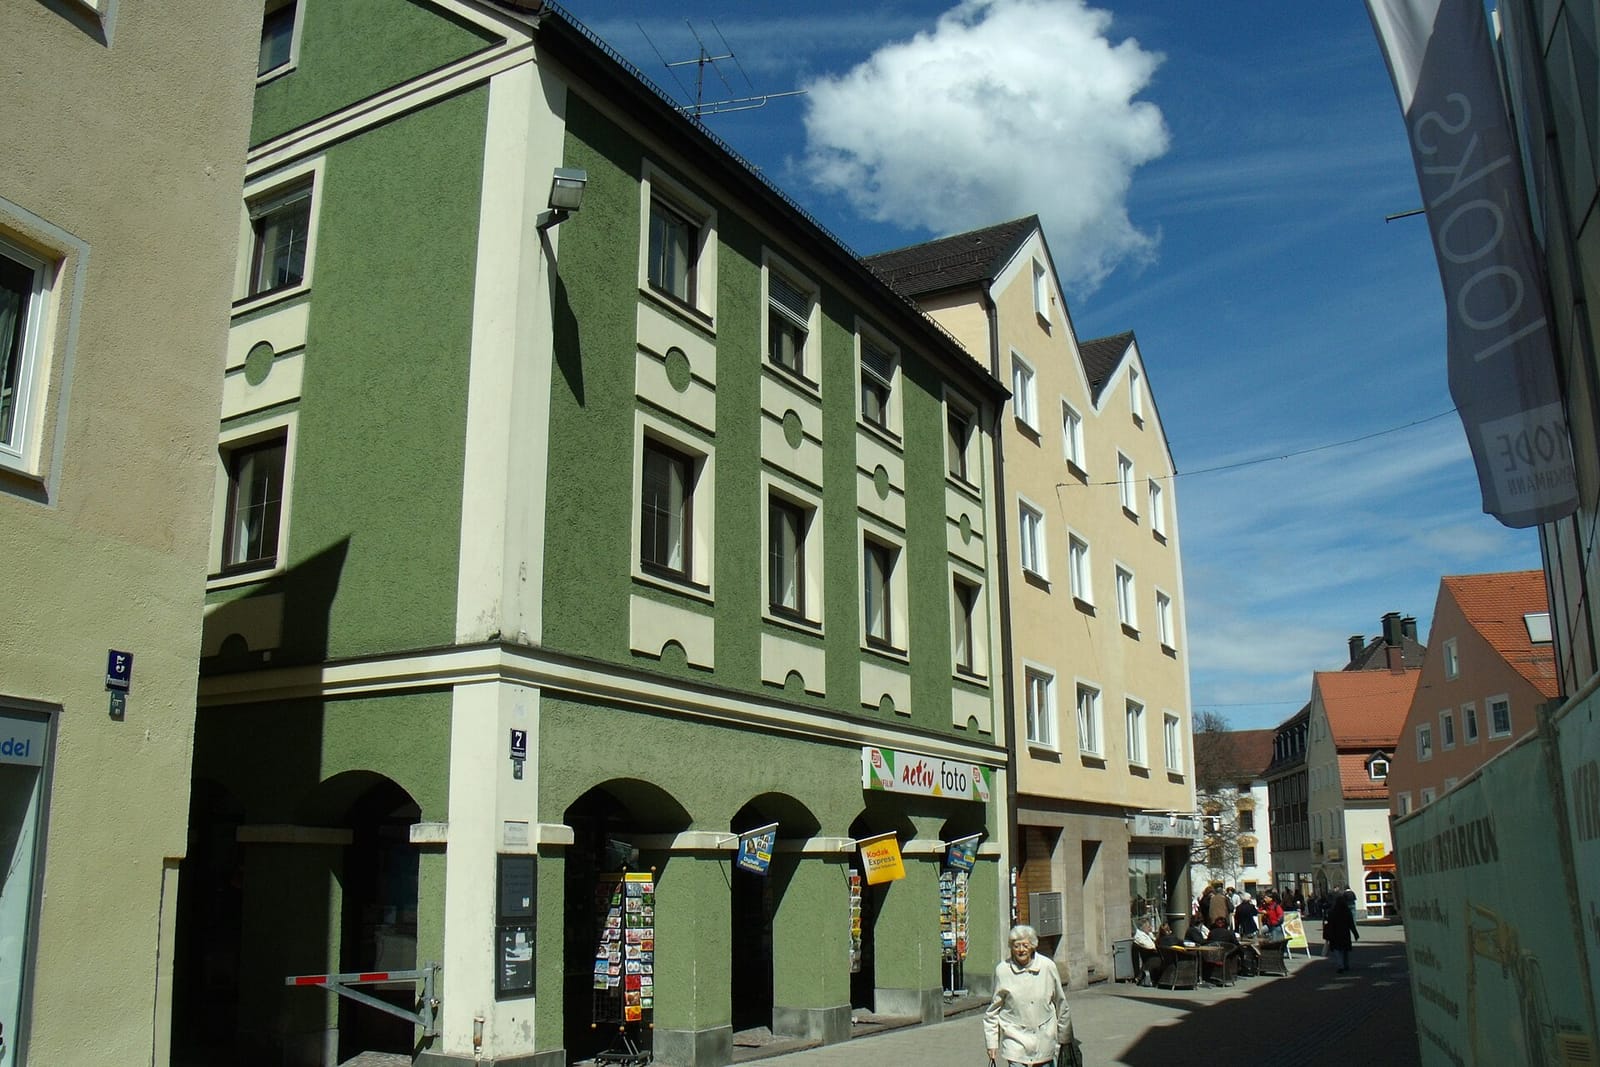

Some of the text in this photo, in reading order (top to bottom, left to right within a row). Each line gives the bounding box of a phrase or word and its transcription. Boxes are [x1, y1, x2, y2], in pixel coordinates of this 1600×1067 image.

[0, 737, 30, 757] del
[514, 731, 523, 747] 7
[902, 760, 935, 789] activ
[940, 761, 967, 792] foto
[866, 848, 889, 858] Kodak
[868, 856, 896, 866] Express
